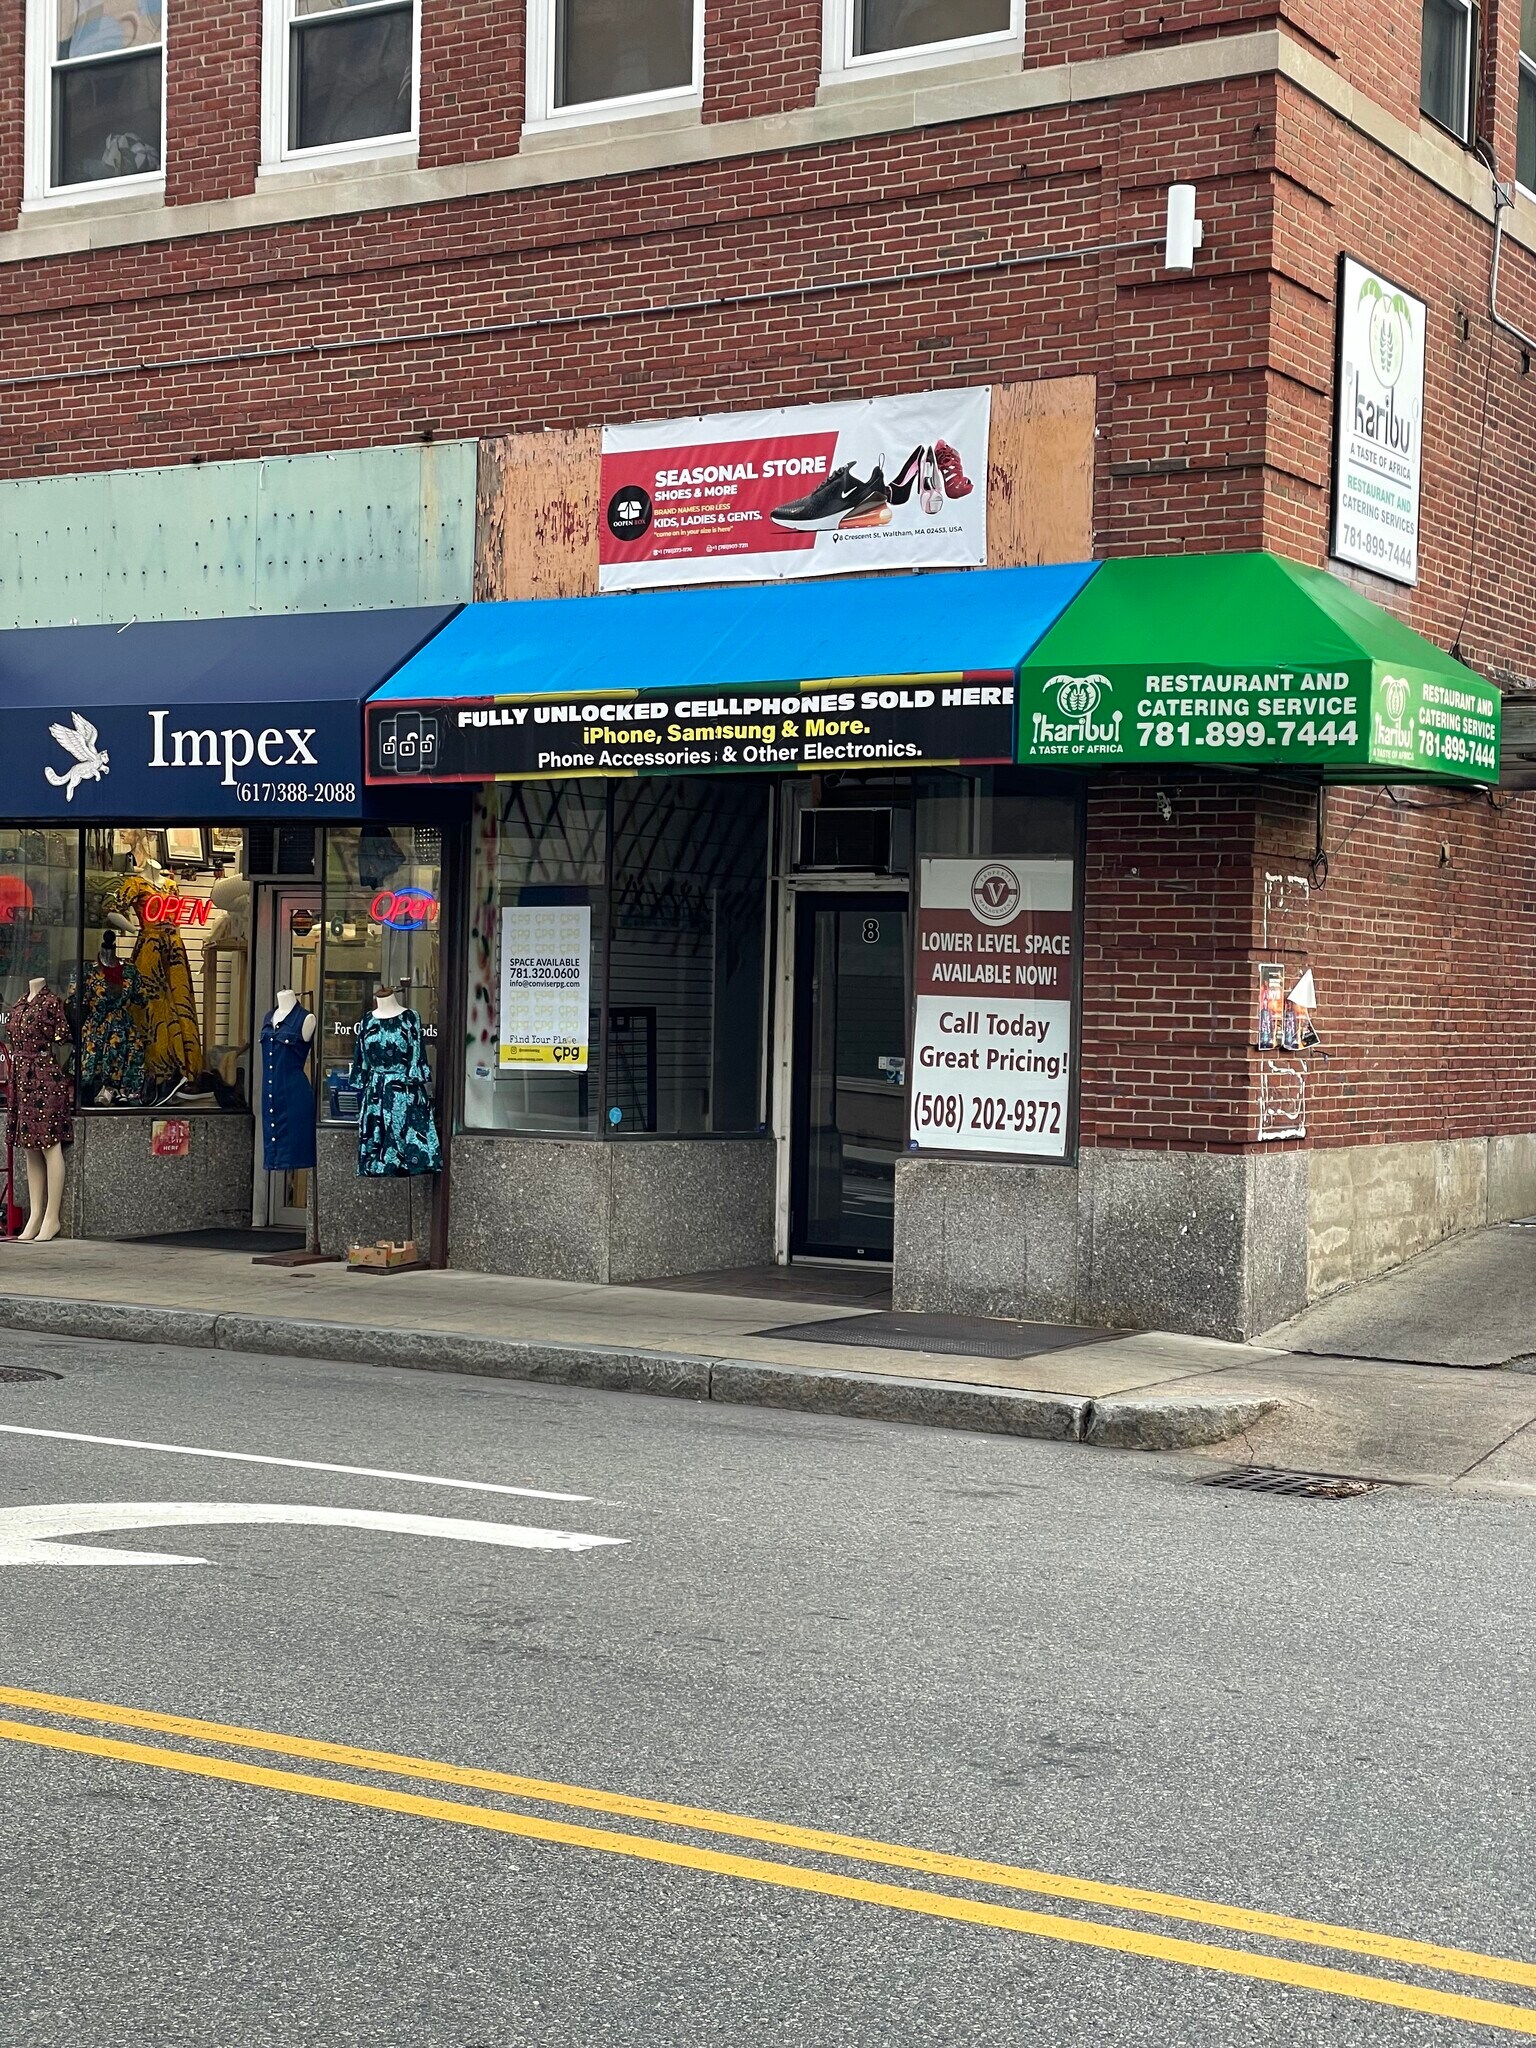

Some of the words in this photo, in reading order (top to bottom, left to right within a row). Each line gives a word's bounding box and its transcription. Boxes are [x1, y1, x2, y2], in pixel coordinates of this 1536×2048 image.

[1355, 370, 1410, 454] karibu
[655, 462, 758, 487] SEASONAL
[762, 455, 827, 477] STORE
[1350, 443, 1355, 455] A
[1357, 445, 1377, 467] TASTE
[1380, 457, 1387, 469] OF
[1389, 460, 1411, 480] AFRICA
[655, 488, 692, 501] SHOES
[694, 487, 701, 498] &
[705, 485, 738, 497] MORE
[1347, 474, 1395, 506] RESTAURANT
[1396, 496, 1411, 513] AND
[654, 507, 677, 516] BRAND
[678, 506, 700, 514] NAMES
[701, 504, 715, 512] FOR
[716, 503, 731, 511] LESS
[654, 518, 679, 528] KIDS,
[681, 514, 716, 526] LADIES
[718, 513, 725, 523] &
[727, 510, 762, 522] GENTS.
[1342, 494, 1379, 521] CATERING
[1381, 510, 1414, 535] SERVICES
[687, 529, 700, 537] your
[844, 533, 872, 541] Crescent
[883, 530, 913, 538] Waltham,
[1344, 523, 1411, 569] 781-899-7444
[1146, 673, 1293, 693] RESTAURANT
[1300, 672, 1348, 691] AND
[458, 708, 529, 728] FULLY
[533, 702, 669, 724] UNLOCKED
[860, 690, 935, 710] SOLD
[1137, 698, 1249, 717] CATERING
[1258, 697, 1357, 716] SERVICE
[1422, 683, 1476, 712] RESTAURANT
[1477, 697, 1493, 717] AND
[583, 725, 662, 745] iPhone,
[781, 719, 799, 738] &
[805, 718, 871, 738] More.
[1041, 712, 1114, 743] karibu
[1136, 720, 1359, 747] 781.899.7444
[1378, 715, 1411, 748] karibu
[1419, 707, 1461, 732] CATERING
[1463, 717, 1496, 741] SERVICE
[148, 710, 318, 786] Impex
[538, 751, 595, 769] Phone
[599, 747, 711, 767] Accessories
[722, 745, 737, 762] &
[743, 744, 798, 763] Other
[804, 739, 922, 760] Electronics.
[1029, 747, 1037, 755] A
[1038, 745, 1069, 755] TASTE
[1071, 745, 1085, 754] OF
[1087, 744, 1123, 754] AFRICA
[1372, 748, 1376, 757] A
[1376, 748, 1391, 759] TASTE
[1392, 750, 1398, 759] OF
[1399, 751, 1414, 760] AFRICA
[1418, 730, 1495, 770] 781-899-7444
[236, 783, 356, 802] (617)388-2088
[985, 882, 1006, 906] V
[145, 894, 214, 927] OPEN
[331, 914, 344, 937] 6
[862, 918, 880, 944] 8
[922, 932, 973, 953] LOWER
[977, 933, 1021, 954] LEVEL
[1024, 934, 1070, 955] SPACE
[509, 958, 535, 967] SPACE
[536, 958, 580, 967] AVAILABLE
[510, 967, 580, 979] 781.320.0600
[932, 962, 1011, 984] AVAILABLE
[1015, 965, 1057, 986] NOW!
[509, 979, 580, 989] info@conviserpg.com
[334, 1022, 351, 1035] For
[510, 1035, 529, 1044] Find
[532, 1035, 551, 1044] Your
[939, 1011, 979, 1035] Call
[986, 1013, 1050, 1043] Today
[919, 1045, 979, 1069] Great
[986, 1049, 1068, 1079] Pricing!
[914, 1092, 963, 1133] (508)
[970, 1097, 1061, 1134] 202-9372
